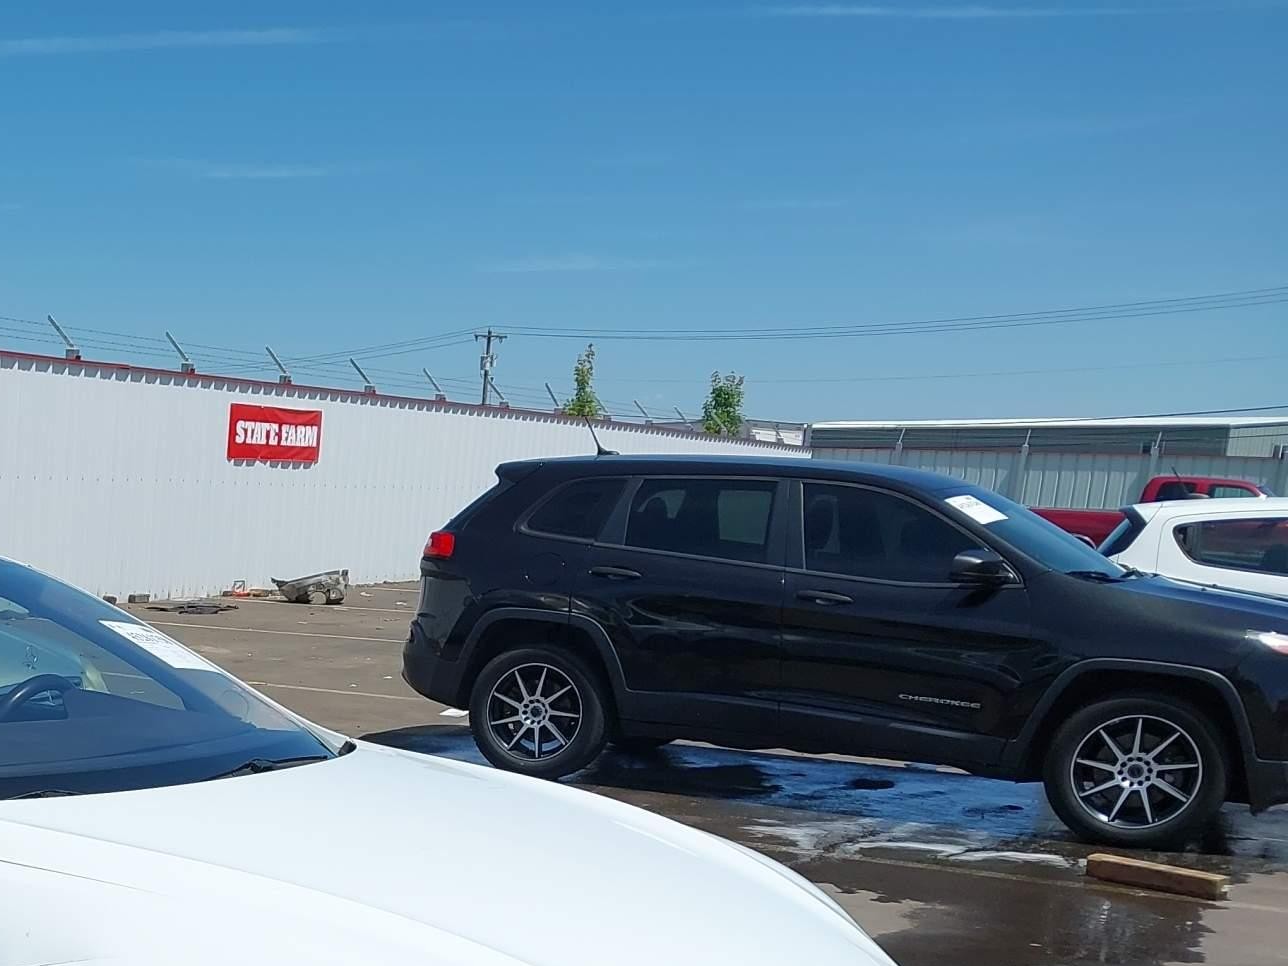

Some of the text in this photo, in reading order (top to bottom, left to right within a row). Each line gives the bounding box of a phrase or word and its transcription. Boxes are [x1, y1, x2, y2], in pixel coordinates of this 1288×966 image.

[235, 420, 318, 448] STATE FARM
[898, 694, 981, 709] CHEROKEE
